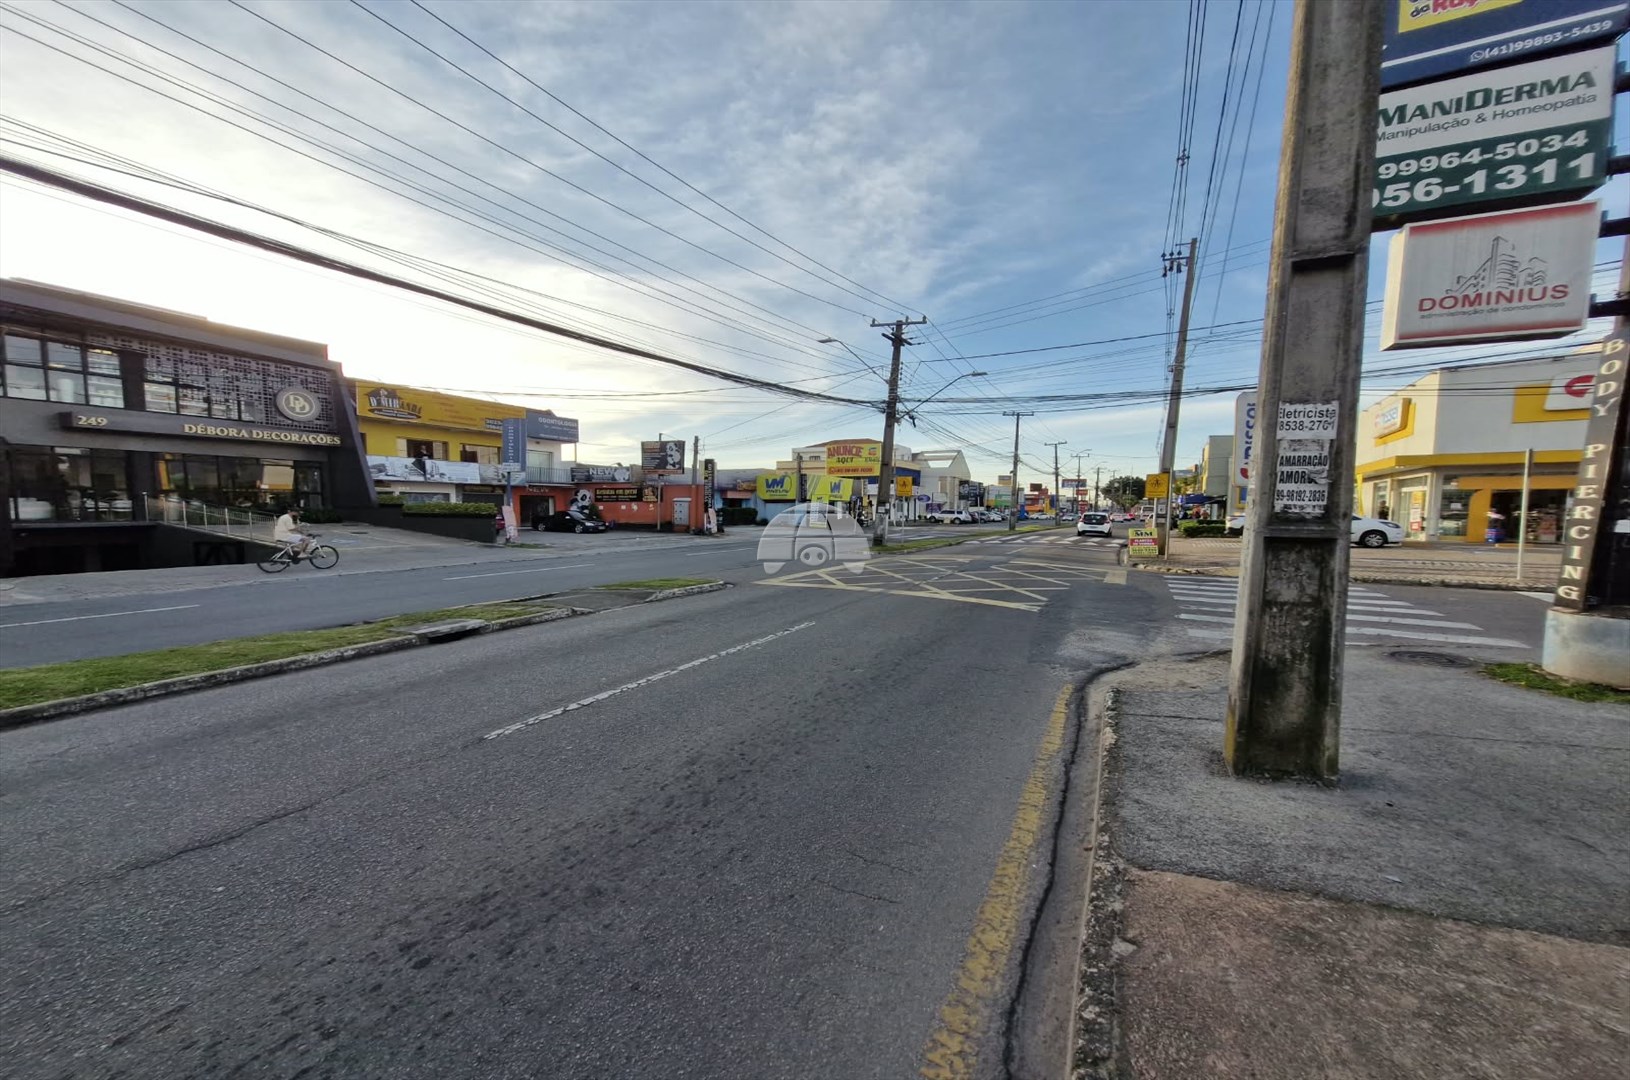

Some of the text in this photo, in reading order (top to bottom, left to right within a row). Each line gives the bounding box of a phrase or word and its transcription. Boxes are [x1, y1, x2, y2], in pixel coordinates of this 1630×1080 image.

[1485, 20, 1613, 58] (41)99893-5439
[1376, 92, 1597, 142] Manipulação & Homeopatia
[1378, 131, 1589, 180] 99964-5034
[1418, 284, 1569, 312] DOMINIUS
[1420, 309, 1484, 319] administração
[1486, 306, 1499, 315] de
[77, 415, 108, 427] 249
[184, 423, 341, 446] DÉBORA DECORAÇÕES
[827, 444, 864, 459] ANUNCIE
[1279, 453, 1328, 469] AMARRAÇÃO
[589, 467, 615, 475] NEW
[1279, 471, 1307, 484] AMOR
[1557, 338, 1626, 601] BODY PIERCING
